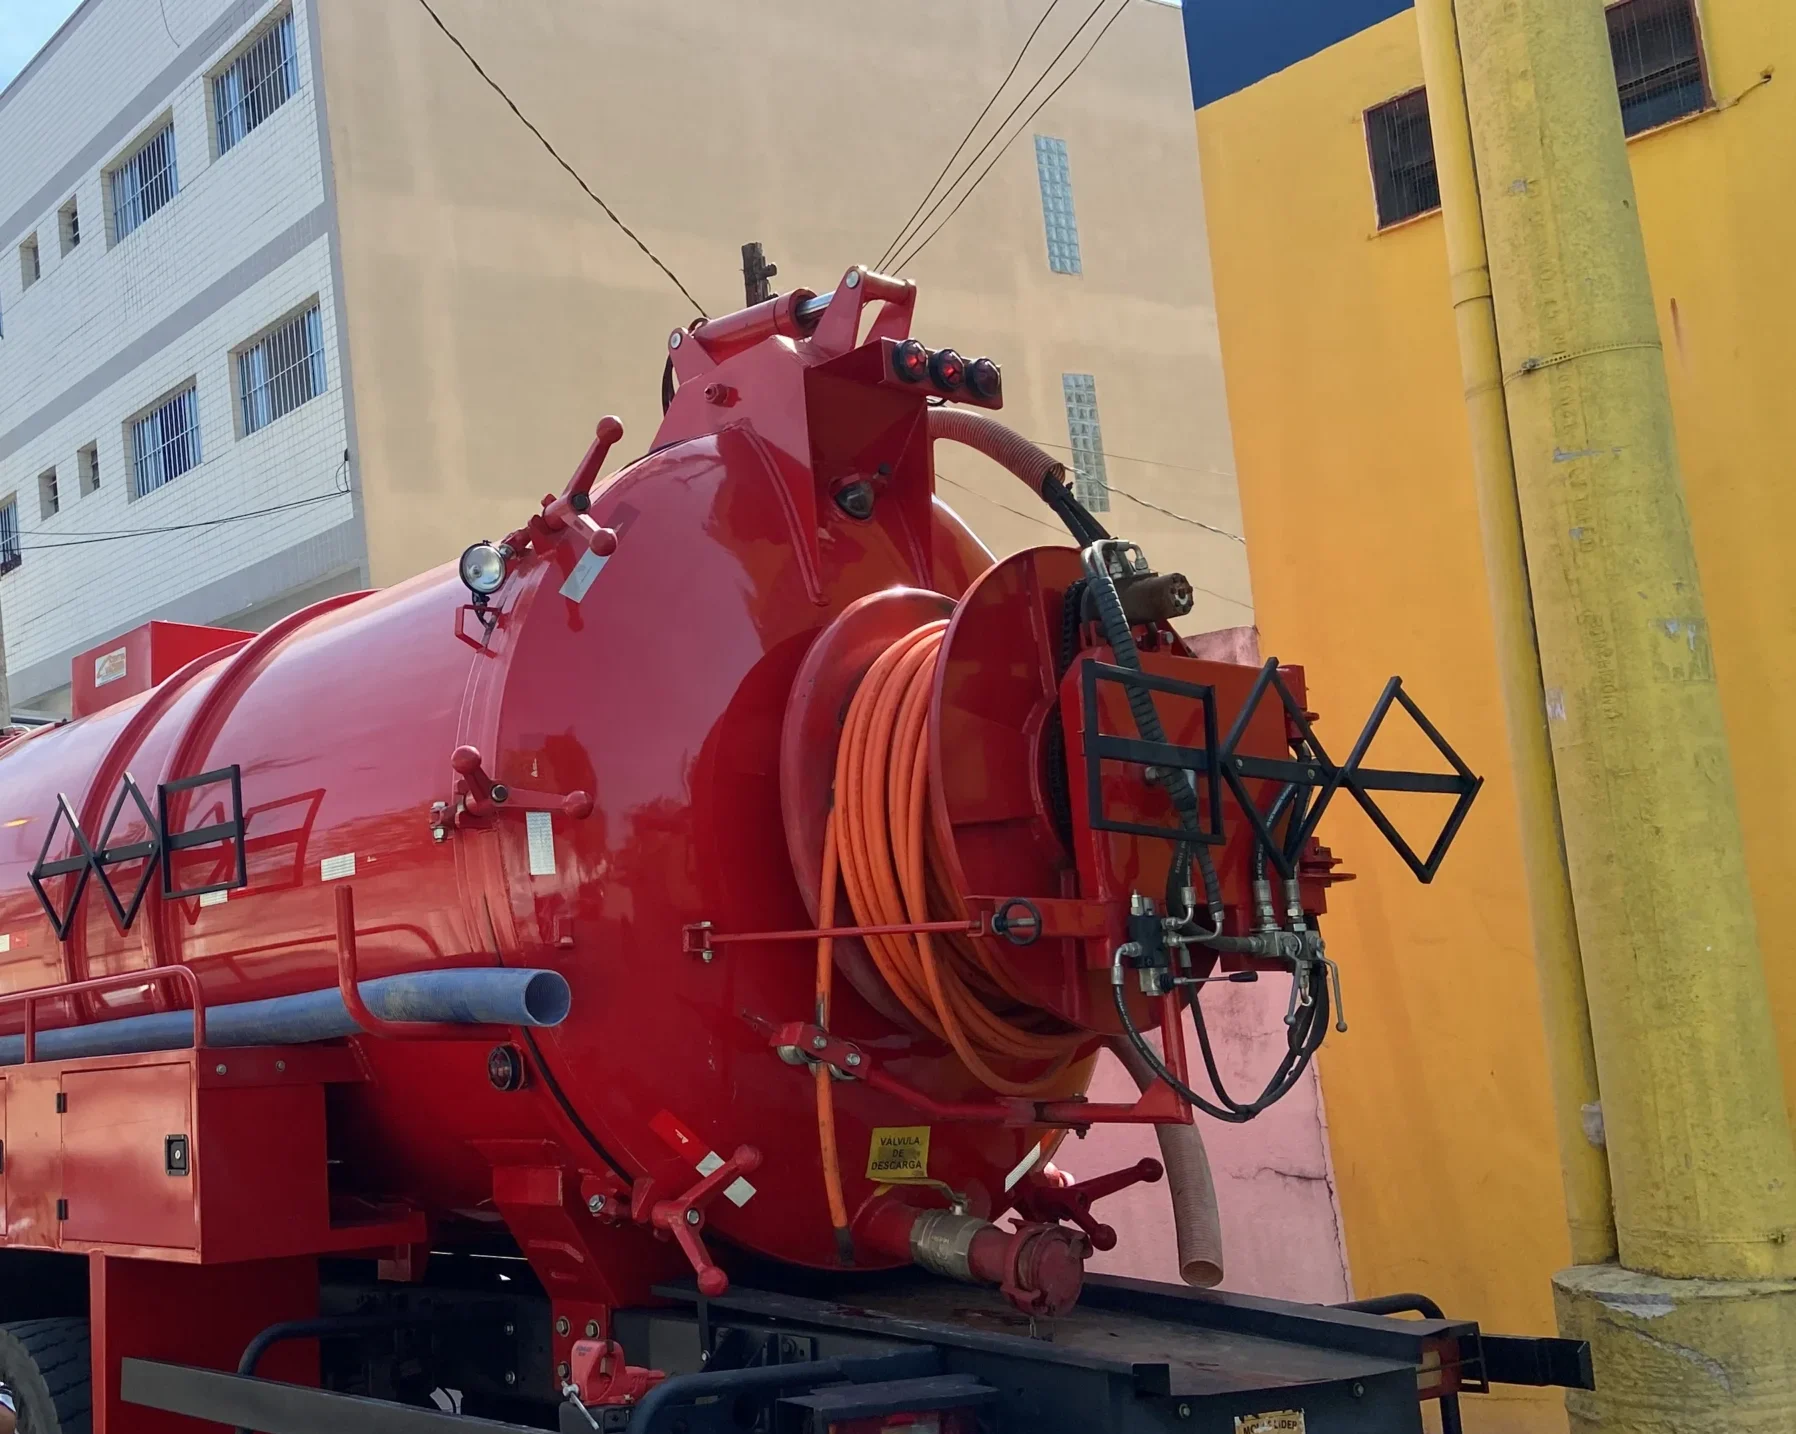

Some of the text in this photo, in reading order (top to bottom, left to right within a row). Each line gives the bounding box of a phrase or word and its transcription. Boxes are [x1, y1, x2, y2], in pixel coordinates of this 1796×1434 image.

[880, 1135, 920, 1146] VÁLVULA
[892, 1149, 904, 1158] DE
[871, 1160, 922, 1170] DESCARGA
